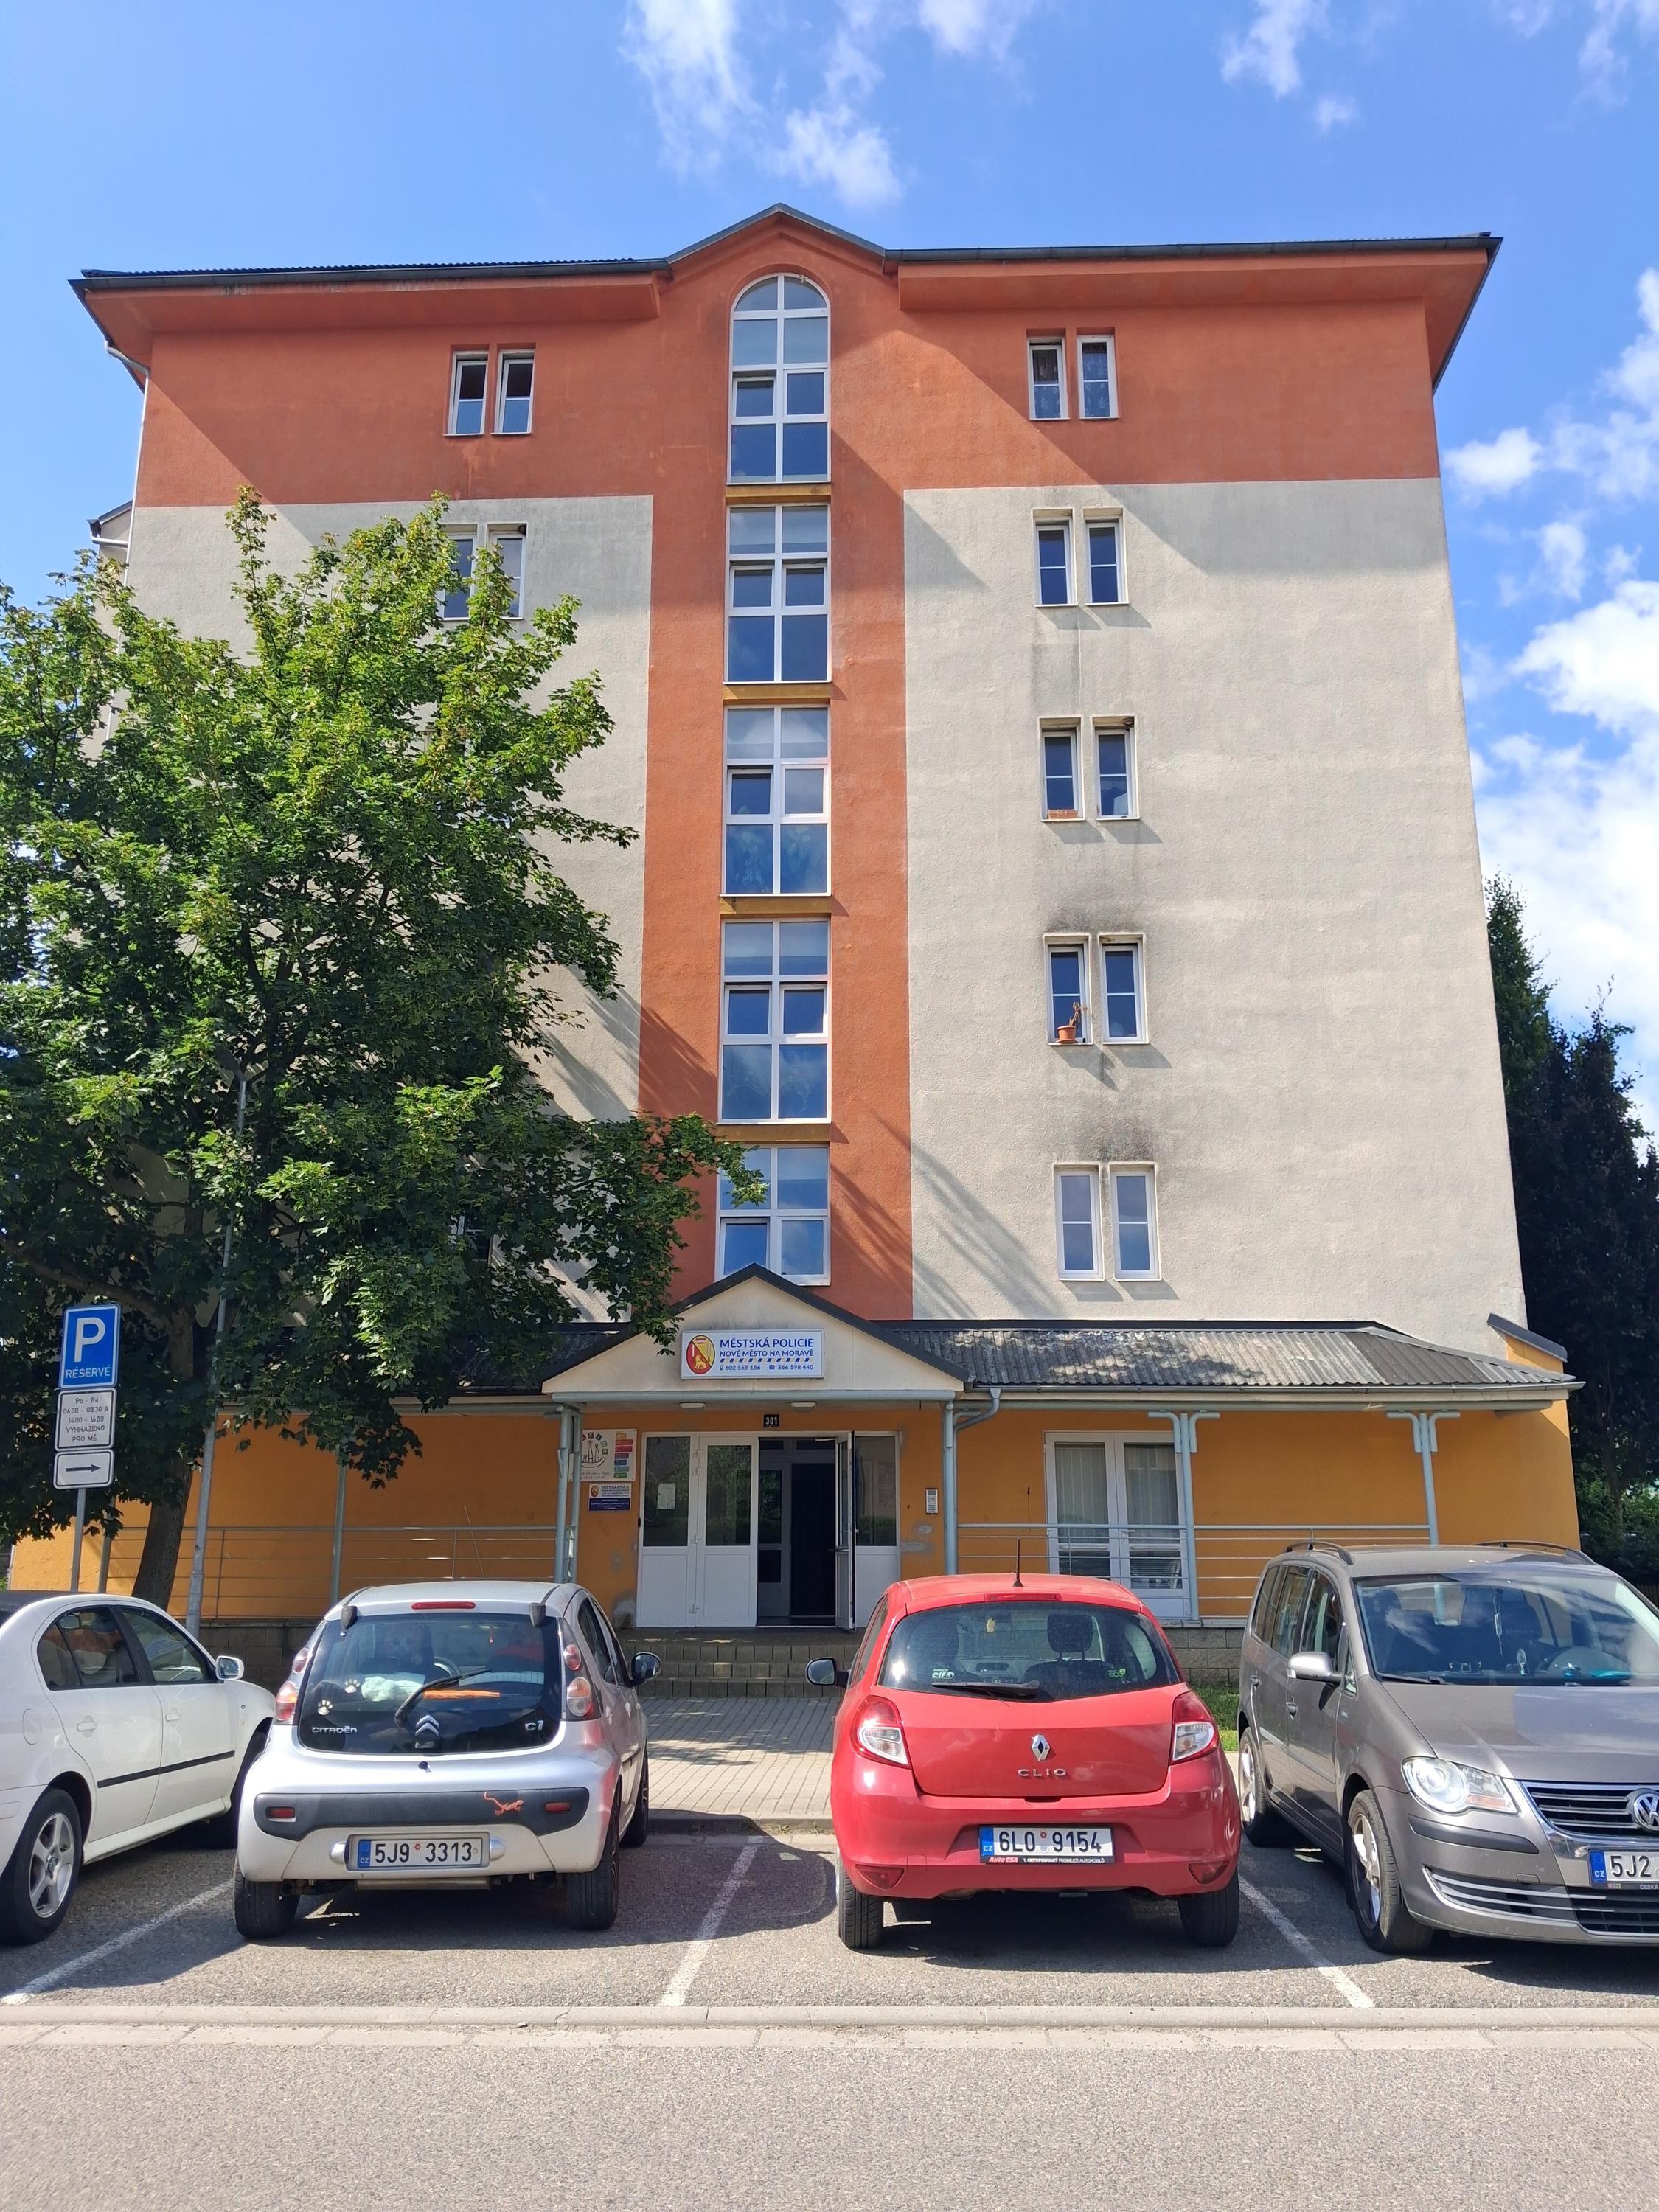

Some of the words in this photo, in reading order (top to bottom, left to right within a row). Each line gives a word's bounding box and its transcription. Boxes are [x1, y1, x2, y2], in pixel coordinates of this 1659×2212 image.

[74, 1317, 106, 1363] P
[720, 1337, 770, 1348] MĚSTSKÁ
[773, 1338, 814, 1348] POLICIE
[782, 1349, 813, 1357] MORAVĚ
[66, 1365, 111, 1379] RÉSERVÉ
[765, 1416, 778, 1425] 301
[66, 1425, 105, 1433] VYHRAZENO
[88, 1433, 97, 1442] MŠ
[1018, 1768, 1067, 1777] CLIO
[1052, 1831, 1102, 1854] 9154
[375, 1843, 410, 1864] 5J9
[425, 1842, 472, 1863] 3313
[1594, 1870, 1605, 1878] CZ
[1610, 1855, 1652, 1878] 5J2
